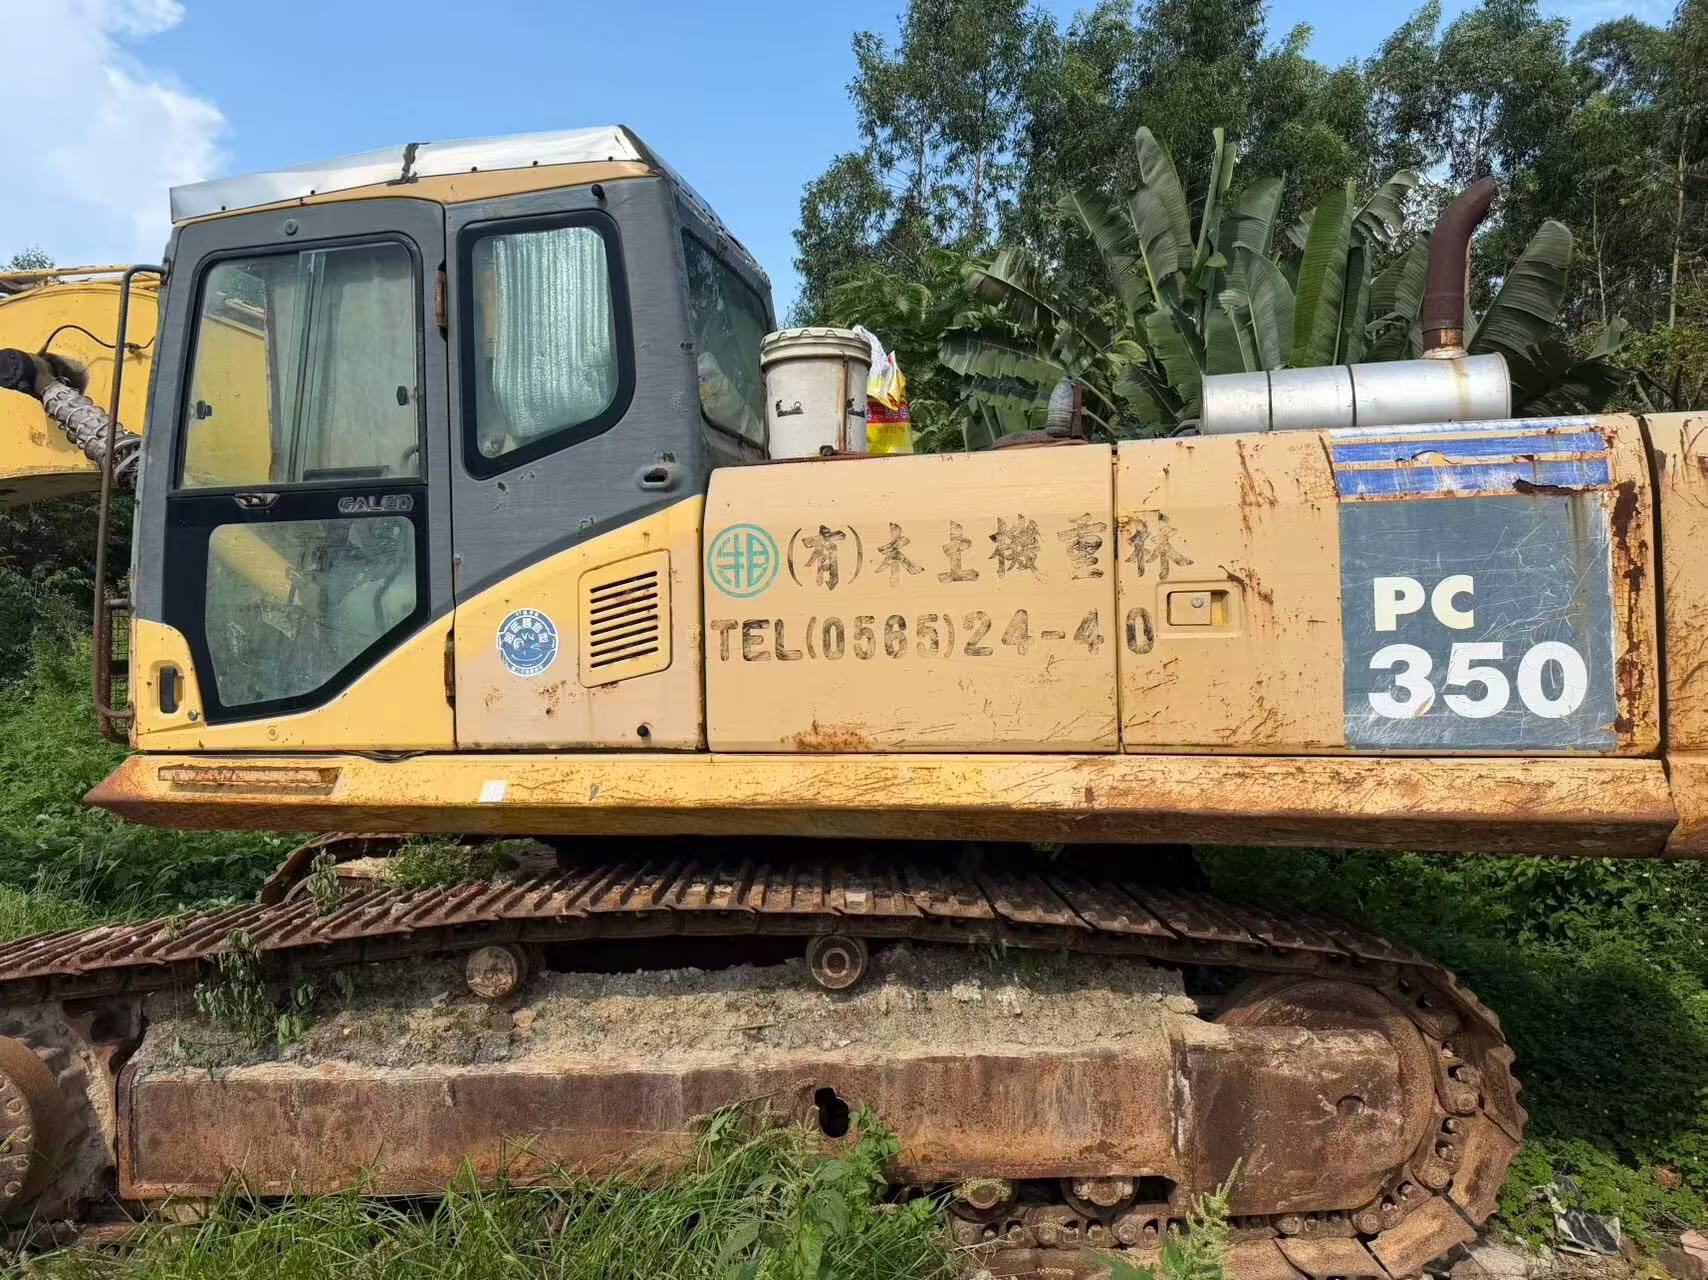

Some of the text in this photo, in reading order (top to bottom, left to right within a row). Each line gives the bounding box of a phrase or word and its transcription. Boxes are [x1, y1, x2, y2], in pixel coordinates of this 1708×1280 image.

[337, 493, 414, 513] GALEO
[1373, 574, 1475, 632] PC
[1367, 640, 1588, 719] 350
